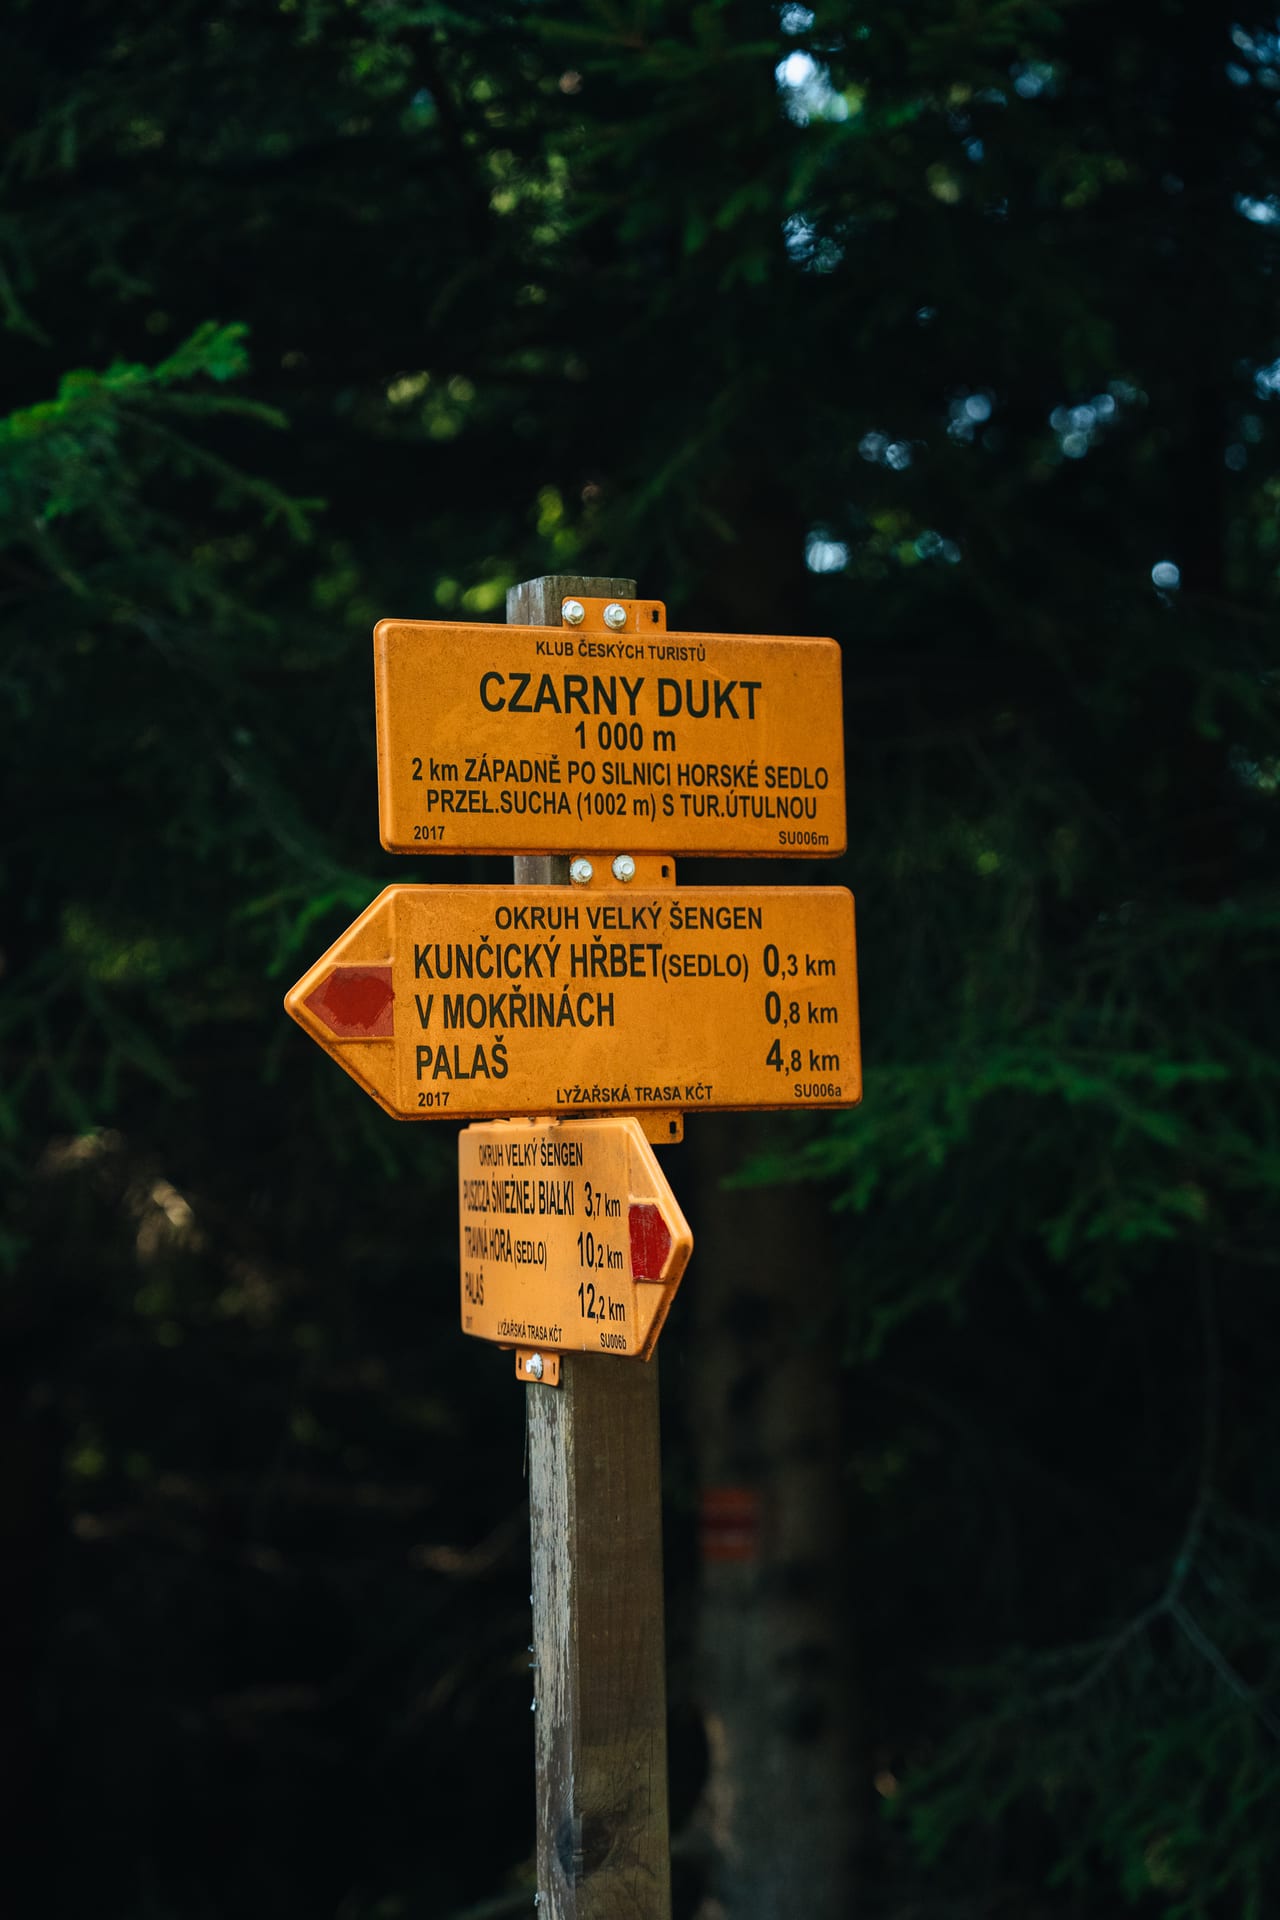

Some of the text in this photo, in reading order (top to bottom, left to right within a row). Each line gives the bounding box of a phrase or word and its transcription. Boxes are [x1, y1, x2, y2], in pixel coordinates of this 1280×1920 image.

[536, 640, 706, 661] KLUB ČESKÝCH TURISTŮ
[480, 671, 762, 719] CZARNY DUKT
[575, 721, 676, 751] 1 000 m
[412, 753, 829, 789] 2 km ZÁPADNĚ PO SILNICI HORSKÉ SEDLO
[577, 792, 627, 821] (1002
[633, 793, 656, 822] m)
[663, 794, 674, 817] S
[680, 790, 817, 819] TUR.ÚTULNOU
[414, 825, 445, 840] 2017
[779, 831, 829, 845] SU006m
[495, 901, 762, 930] OKRUH VELKÝ ŠENGEN
[414, 935, 561, 979] KUNČICKÝ
[763, 944, 798, 980] 0,3
[805, 954, 836, 977] km
[414, 984, 838, 1029] V MOKŘINÁCH 0,8 km
[416, 1035, 840, 1080] PALAŠ 4,8 km
[418, 1092, 450, 1107] 2017
[556, 1083, 713, 1103] LYŽAŘSKÁ TRASA KČT
[794, 1083, 841, 1097] SU006a
[479, 1137, 583, 1166] OKRUH VELKÝ ŠENGEN
[538, 1181, 575, 1216] BIAŁKI
[584, 1181, 601, 1220] 3,7
[605, 1193, 621, 1217] km
[489, 1228, 512, 1263] HORA
[514, 1239, 547, 1272] (SEDLO)
[577, 1232, 604, 1272] 10,2
[607, 1244, 623, 1269] km
[578, 1282, 605, 1323] 12,2
[609, 1296, 626, 1322] km
[497, 1319, 562, 1342] LYŽAŘSKÁ TRASA KČT
[600, 1333, 627, 1350] SU006b
